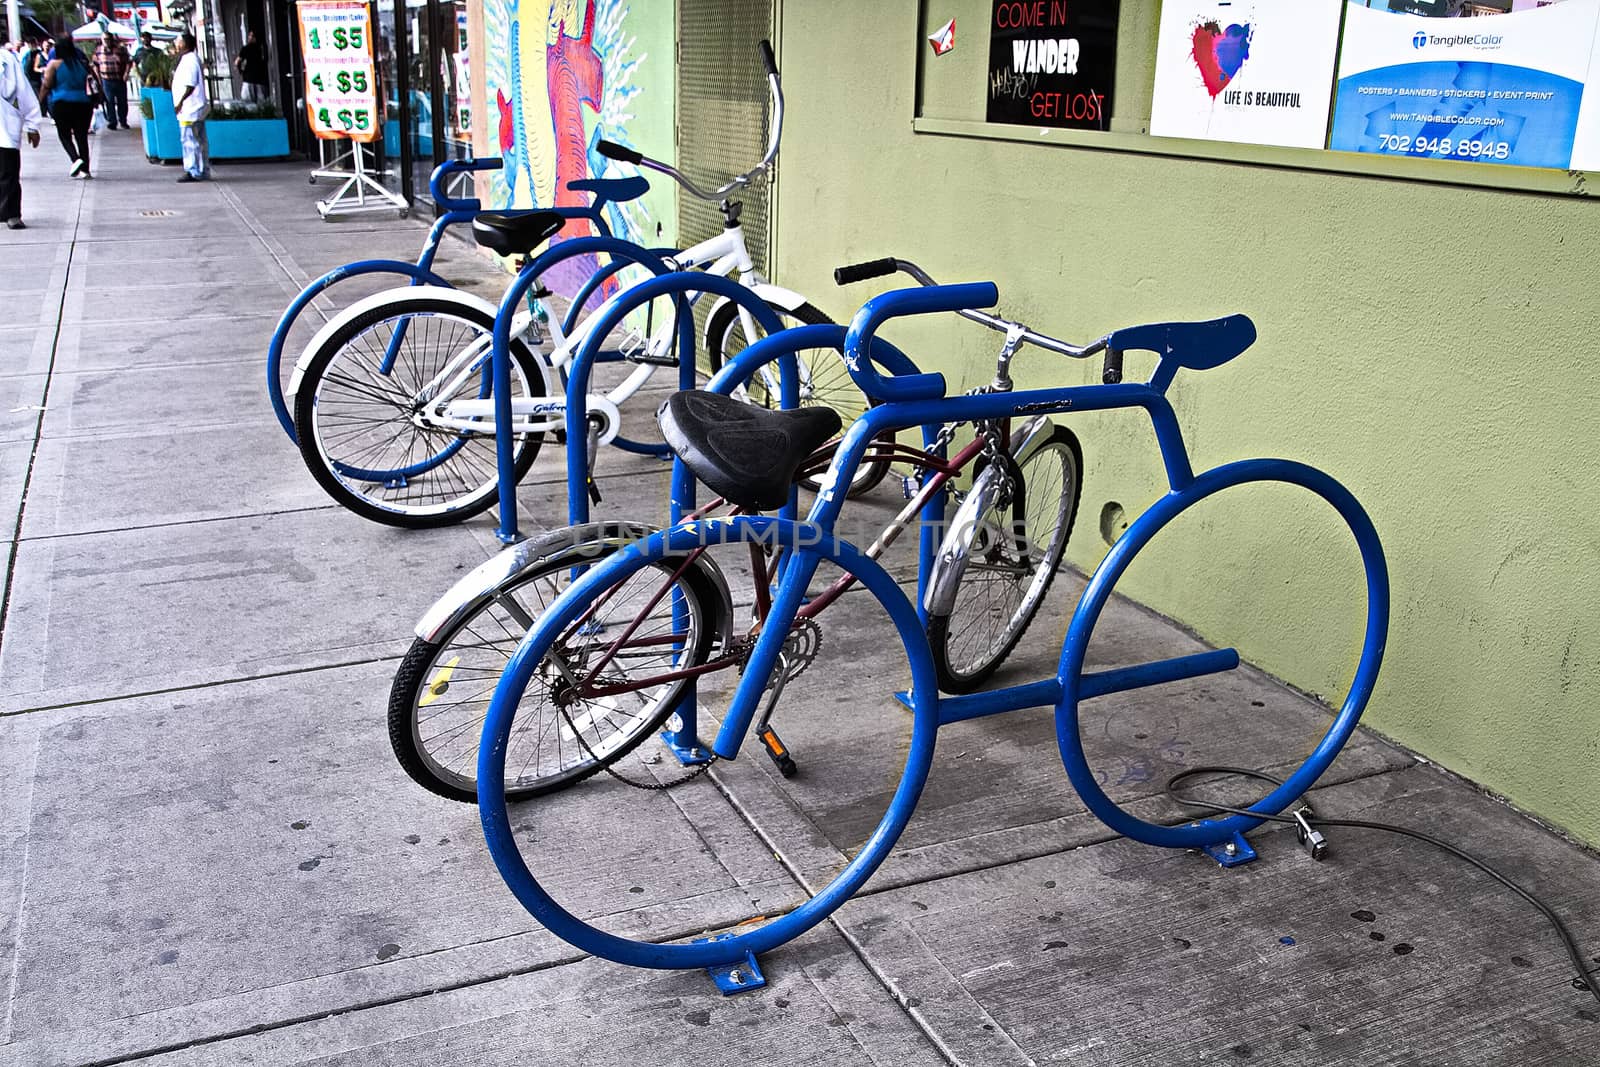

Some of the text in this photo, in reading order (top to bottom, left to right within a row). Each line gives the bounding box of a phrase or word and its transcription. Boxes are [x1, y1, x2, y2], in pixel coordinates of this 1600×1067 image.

[997, 0, 1067, 28] COME IN
[333, 26, 363, 51] $5
[1428, 34, 1504, 48] TangibleColor
[1012, 38, 1080, 76] WANDER
[336, 70, 368, 94] $5
[1358, 86, 1554, 101] POSTERS BANNERS STICKERS EVENT PRINT
[1031, 92, 1105, 120] GET LOST
[1224, 90, 1242, 105] LIFE
[1244, 91, 1253, 106] IS
[1255, 92, 1302, 109] BEAUTIFUL
[337, 108, 370, 131] $5
[1378, 134, 1510, 160] 702.948.8948
